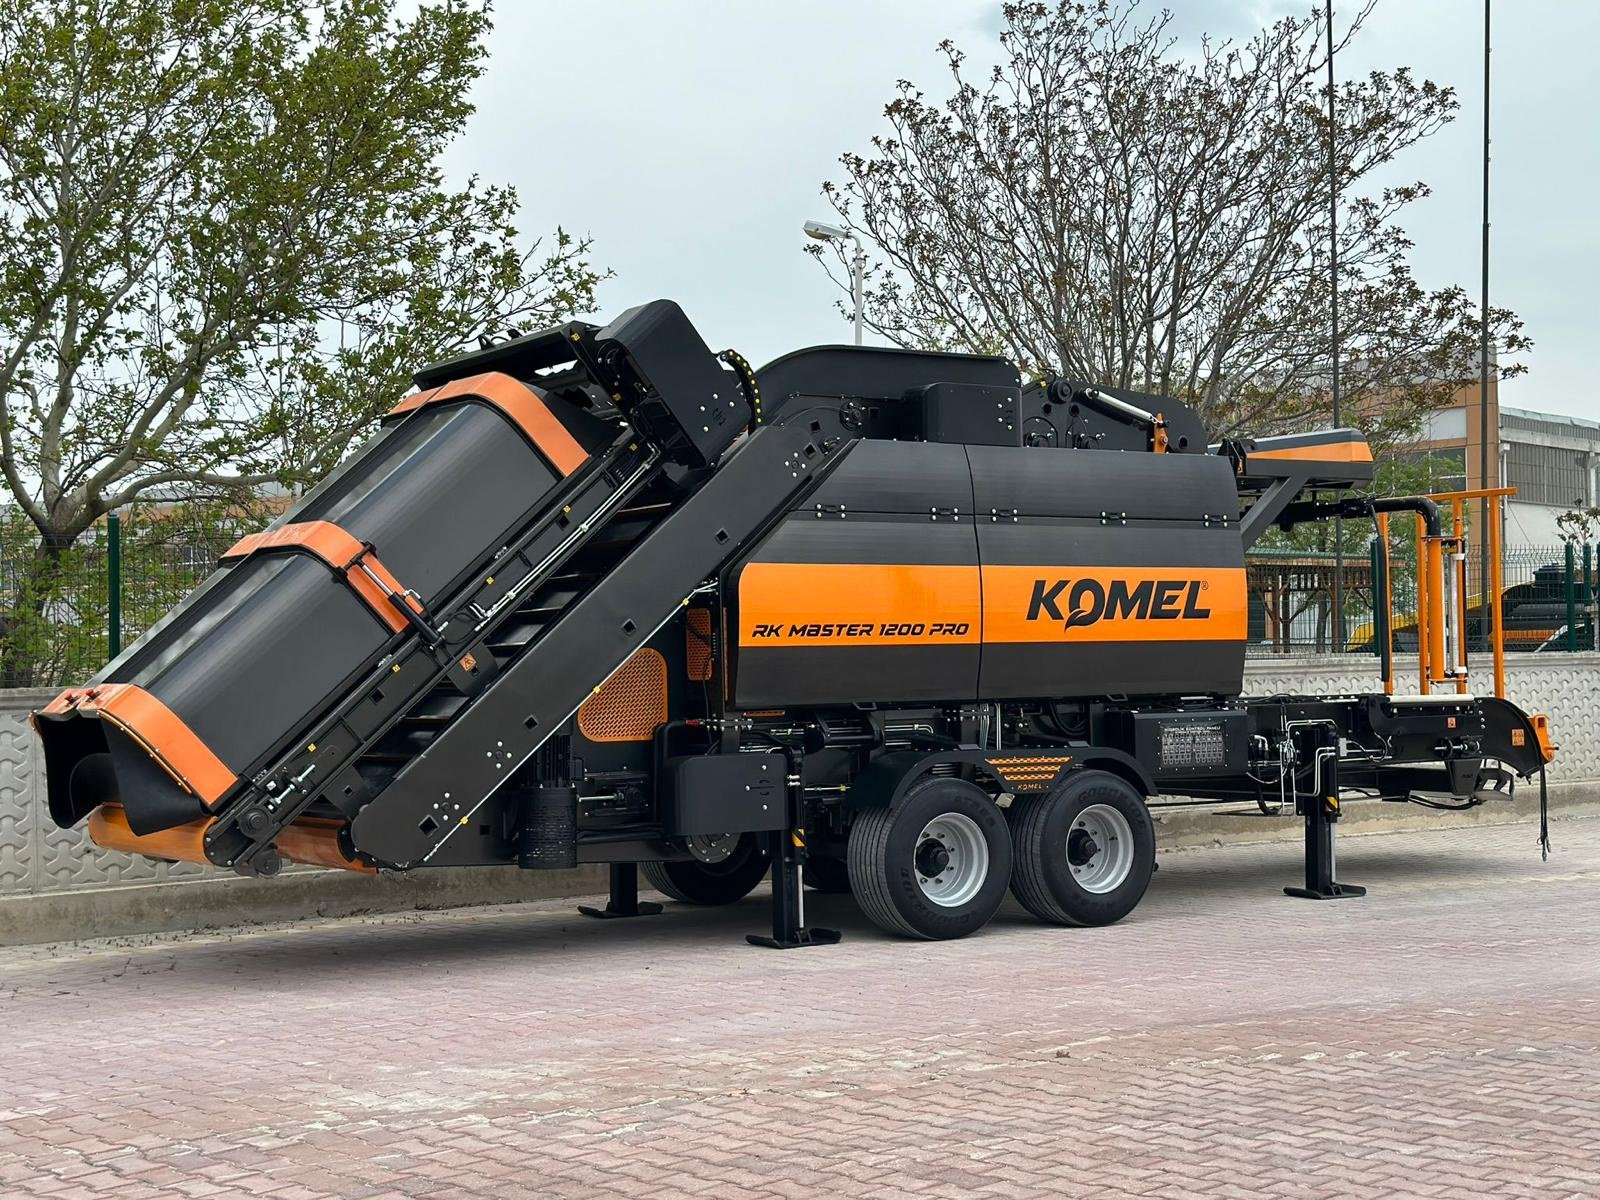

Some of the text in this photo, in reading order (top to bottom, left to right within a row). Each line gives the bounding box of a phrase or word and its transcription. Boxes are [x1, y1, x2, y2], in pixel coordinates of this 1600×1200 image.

[752, 624, 784, 638] RK
[879, 623, 925, 636] 1200
[929, 623, 969, 636] PRO
[1017, 783, 1042, 791] KOMEL
